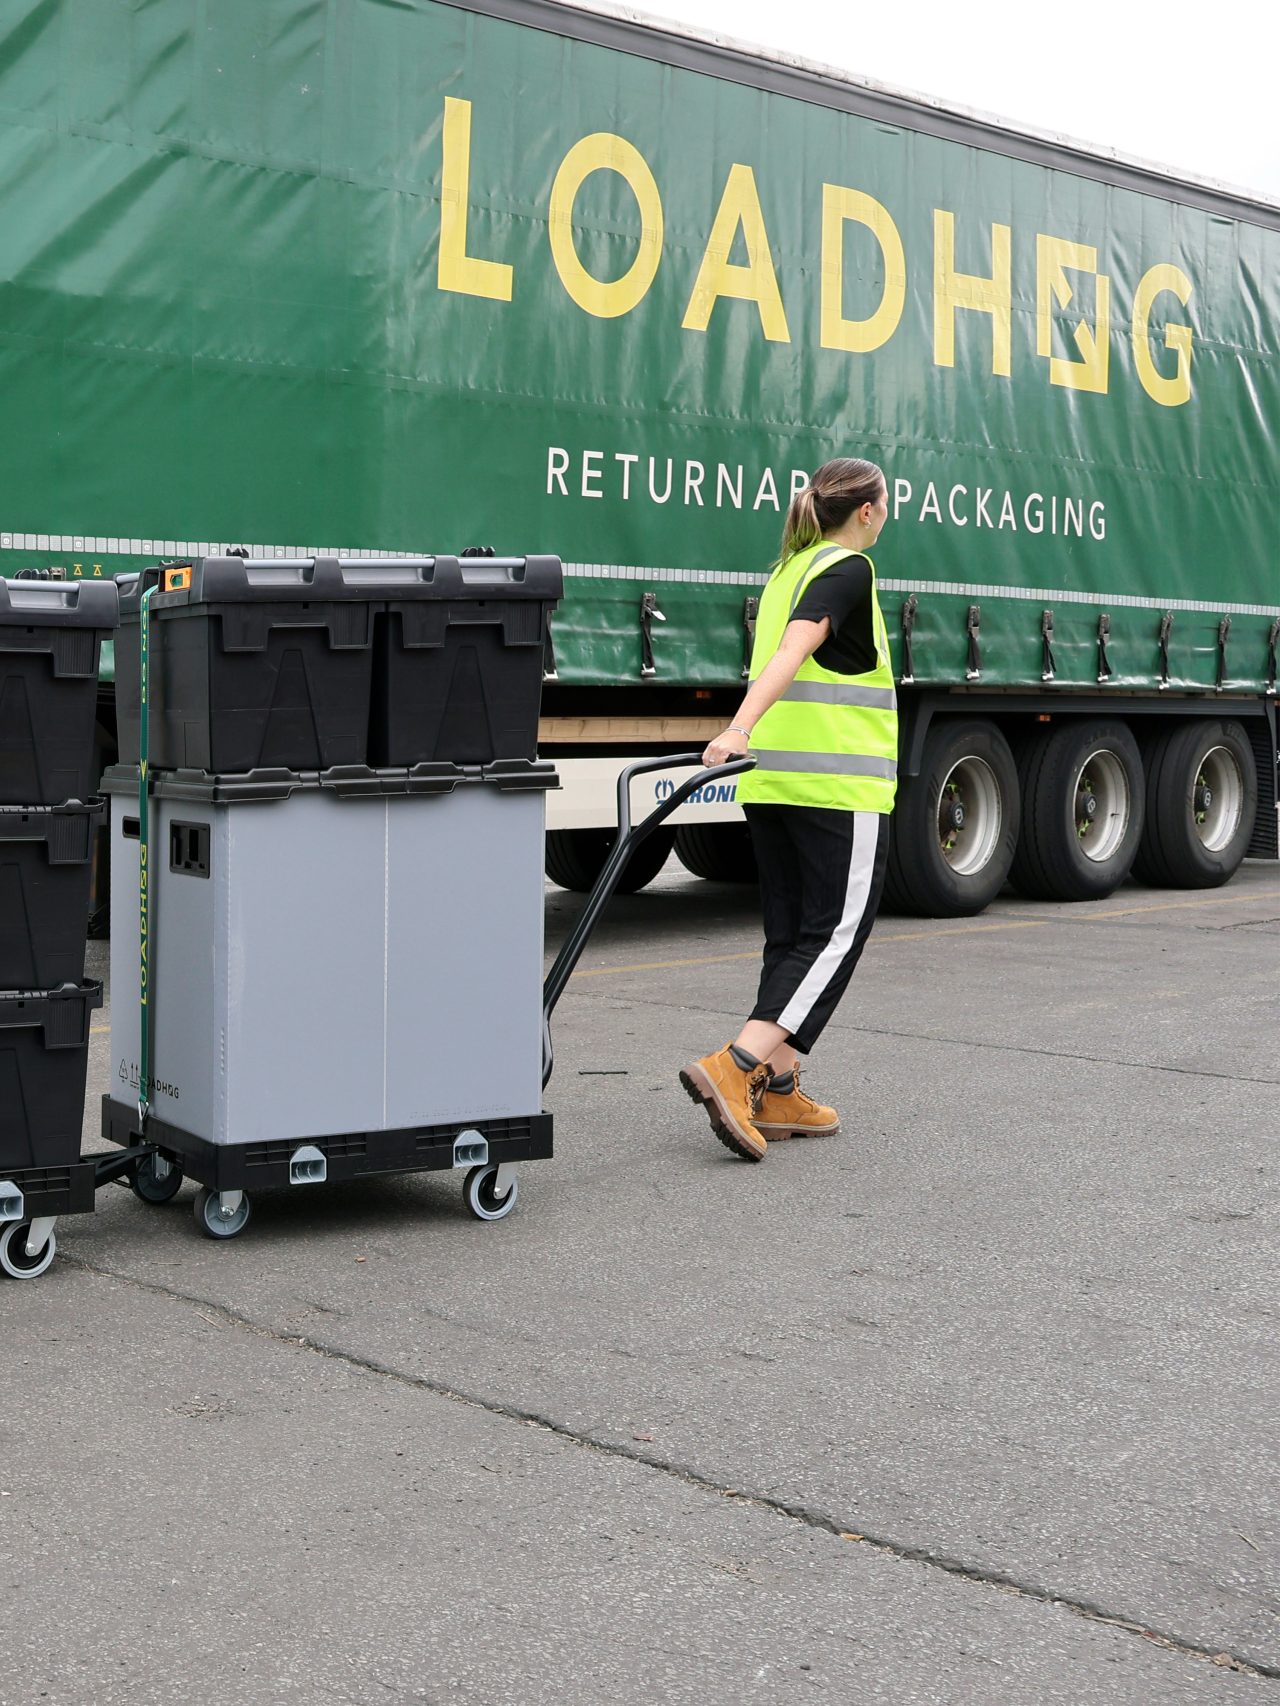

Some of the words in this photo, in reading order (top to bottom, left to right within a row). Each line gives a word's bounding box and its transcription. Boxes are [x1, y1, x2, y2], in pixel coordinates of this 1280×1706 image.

[437, 95, 1194, 407] LOADHOG
[893, 478, 1106, 540] PACKAGING
[683, 784, 737, 805] RON
[140, 844, 148, 1005] LOADHOG
